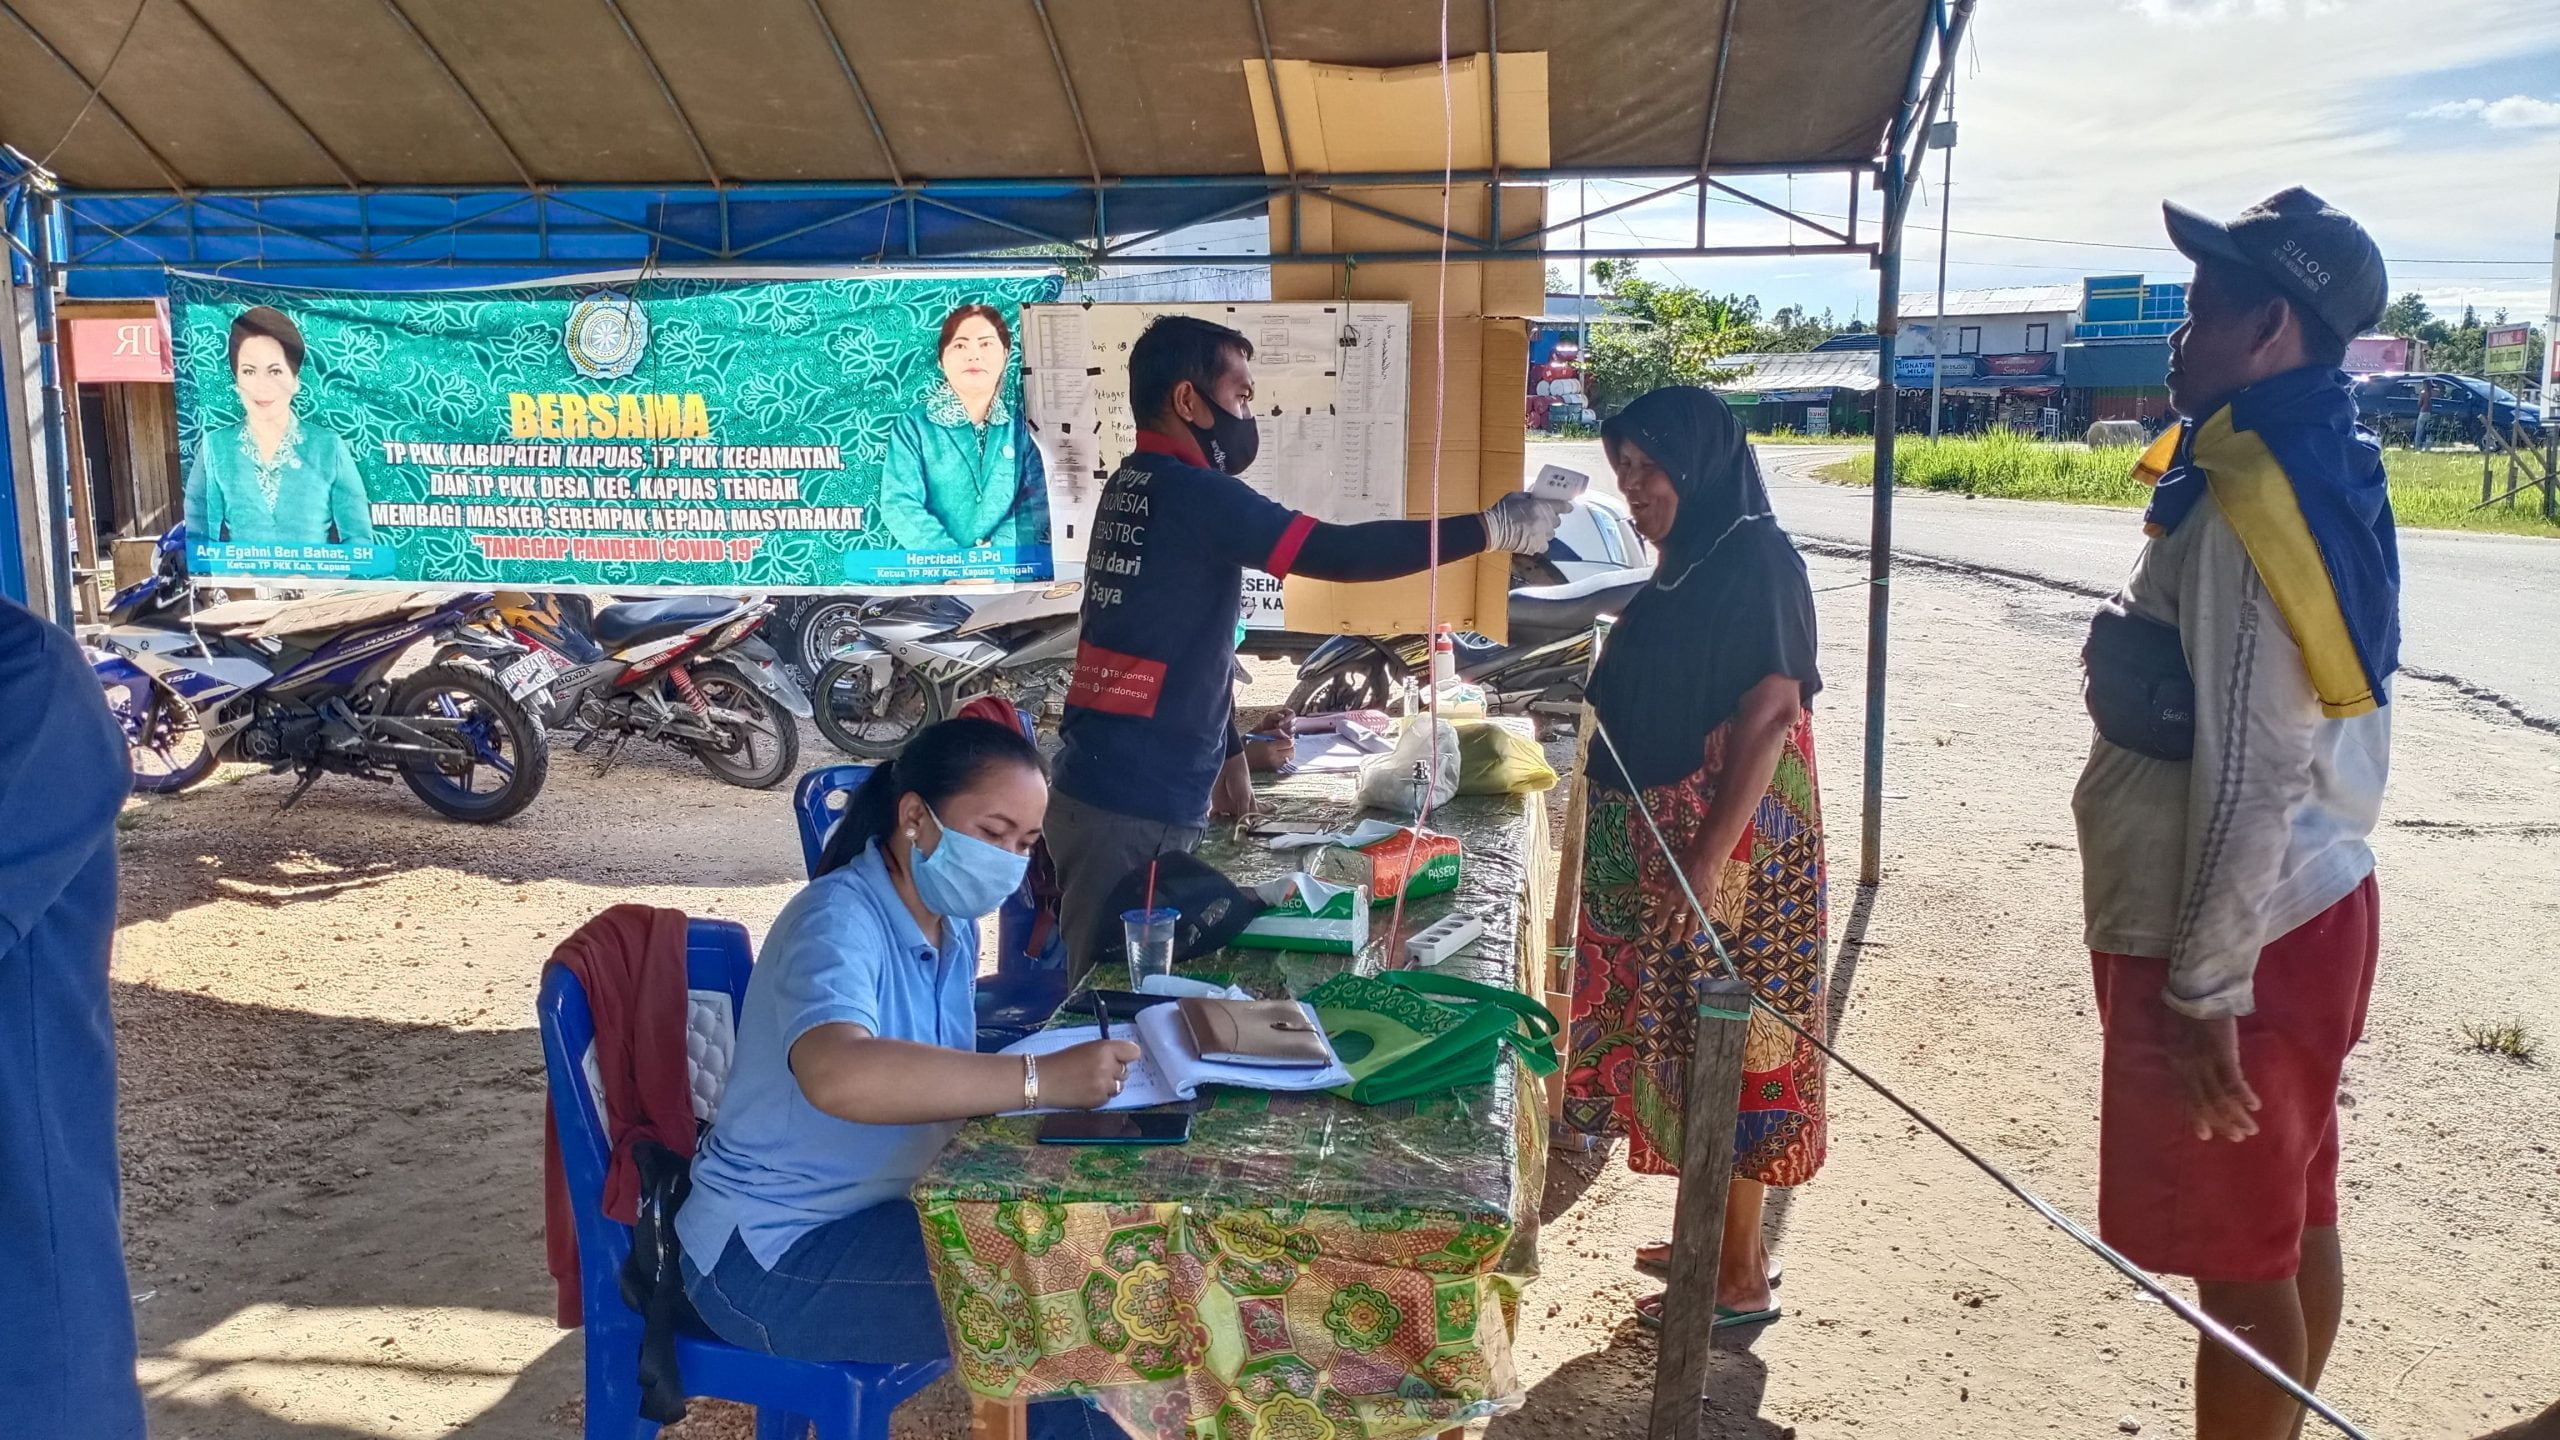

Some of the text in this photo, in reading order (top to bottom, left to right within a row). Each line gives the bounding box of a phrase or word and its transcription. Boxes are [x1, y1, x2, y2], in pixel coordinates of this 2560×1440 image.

[509, 393, 711, 439] BERSAMA
[383, 443, 845, 470] TP PKK KABUPATEN KAPUAS, TP PKK KECAMATAN,
[430, 473, 800, 500] DAN TP PKK DESA KEC. KAPUAS TENGAH
[372, 503, 864, 531] MEMBAGI MASKER SEREMPAK KEPADA MASYARAKAT
[1114, 521, 1146, 546] TBC
[196, 544, 374, 561] Ary Egahni Ben Bahat, SH
[573, 538, 659, 561] PANDEMI
[662, 538, 726, 562] COVID
[967, 550, 1001, 563] S.Pd
[226, 560, 351, 573] Ketua TP PKK Kab. Kapuas
[876, 568, 906, 578] Ketua
[907, 568, 920, 577] TP
[922, 568, 940, 577] PKK
[962, 566, 995, 578] Kapuas
[998, 565, 1034, 576] Tengah
[1106, 551, 1142, 577] dari
[1091, 580, 1123, 610] Saya
[166, 671, 198, 684] 150
[557, 668, 592, 686] HONDA
[1428, 865, 1458, 880] PASEO
